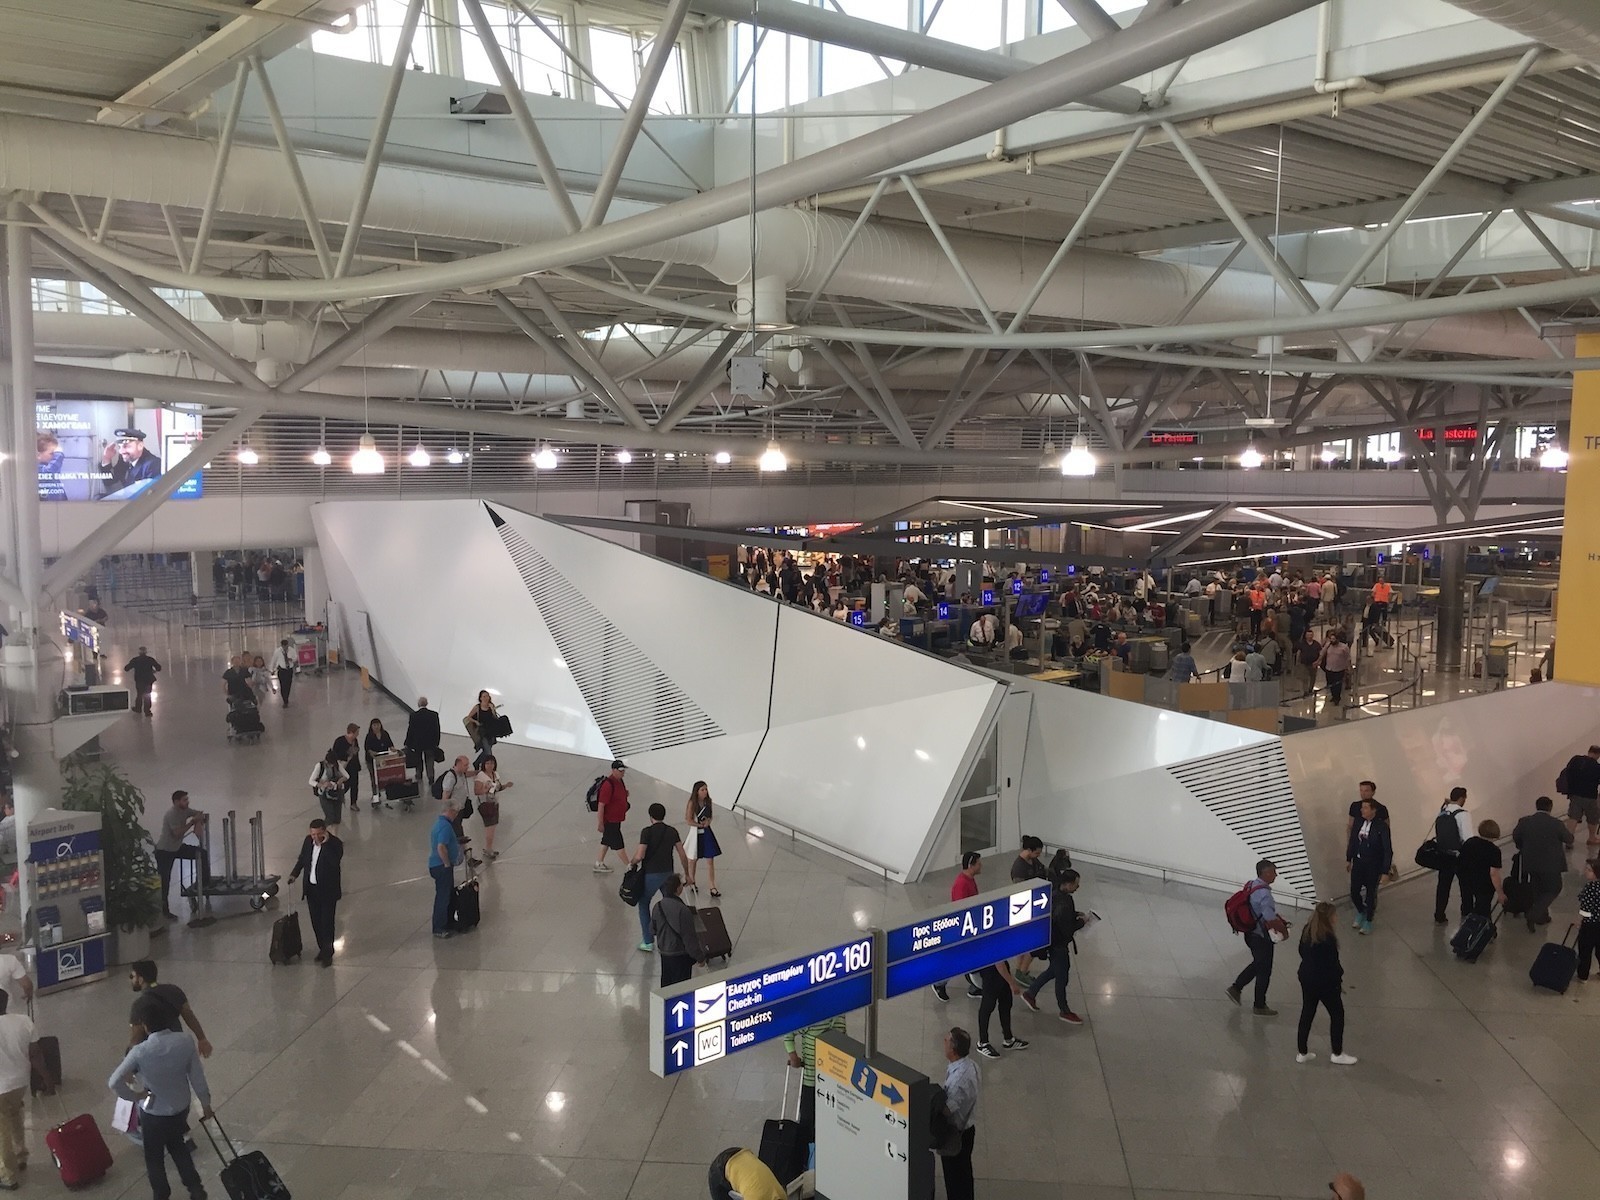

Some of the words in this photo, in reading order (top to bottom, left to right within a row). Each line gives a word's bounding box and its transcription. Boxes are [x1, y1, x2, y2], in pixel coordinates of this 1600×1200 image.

[1419, 427, 1433, 439] La
[1444, 427, 1478, 439] asteria
[1042, 572, 1048, 580] 11
[1014, 582, 1021, 591] 12
[984, 592, 992, 602] 13
[853, 614, 862, 625] 15
[939, 607, 947, 616] 14
[30, 826, 57, 837] Airport
[58, 823, 75, 832] Info
[912, 924, 930, 939] Προς
[933, 916, 960, 933] Εξόδους
[961, 910, 977, 937] A,
[982, 905, 994, 930] B
[912, 939, 922, 952] All
[923, 935, 941, 949] Gates
[807, 941, 871, 985] 102-160
[726, 977, 762, 997] Έλεγχος
[727, 992, 762, 1012] Check-in
[730, 1010, 772, 1033] Τουαλέτες
[701, 1035, 719, 1050] WC
[730, 1031, 755, 1048] Toilets
